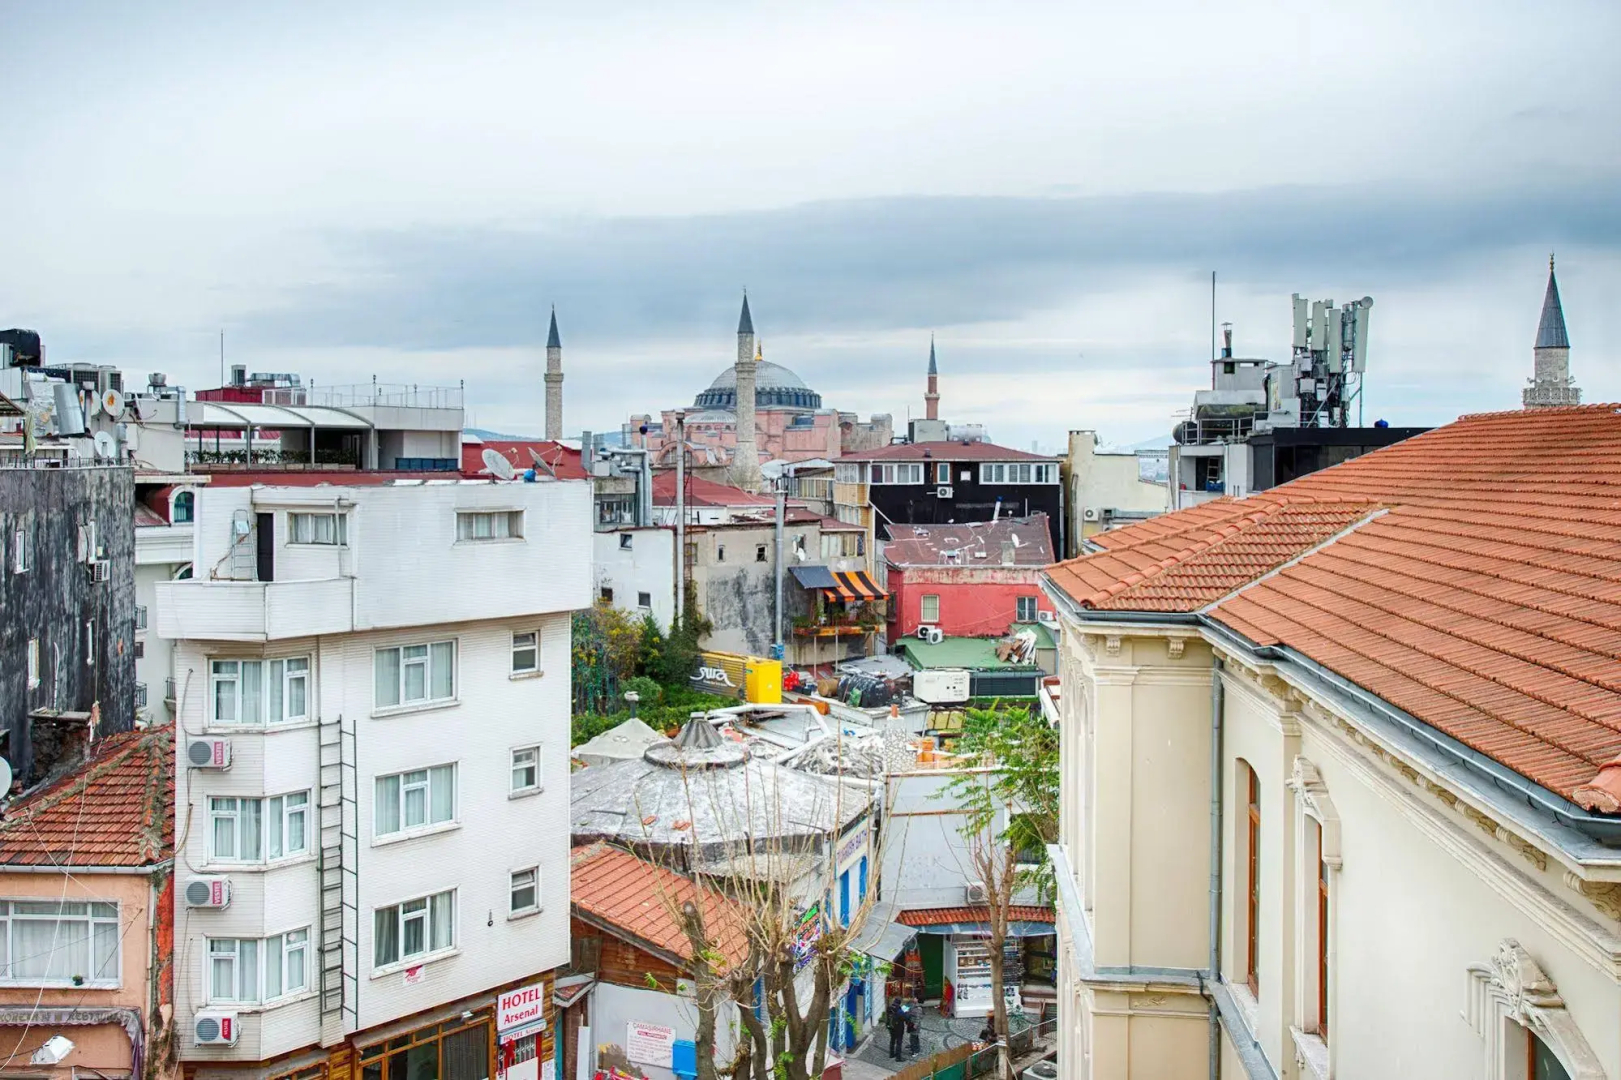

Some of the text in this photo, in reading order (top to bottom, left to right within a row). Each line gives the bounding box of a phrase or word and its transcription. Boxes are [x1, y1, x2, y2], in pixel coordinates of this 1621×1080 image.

[213, 882, 221, 904] VESTEL
[502, 988, 541, 1011] HOTEL
[504, 1005, 538, 1025] Arsenal
[503, 1031, 523, 1042] HOTEL
